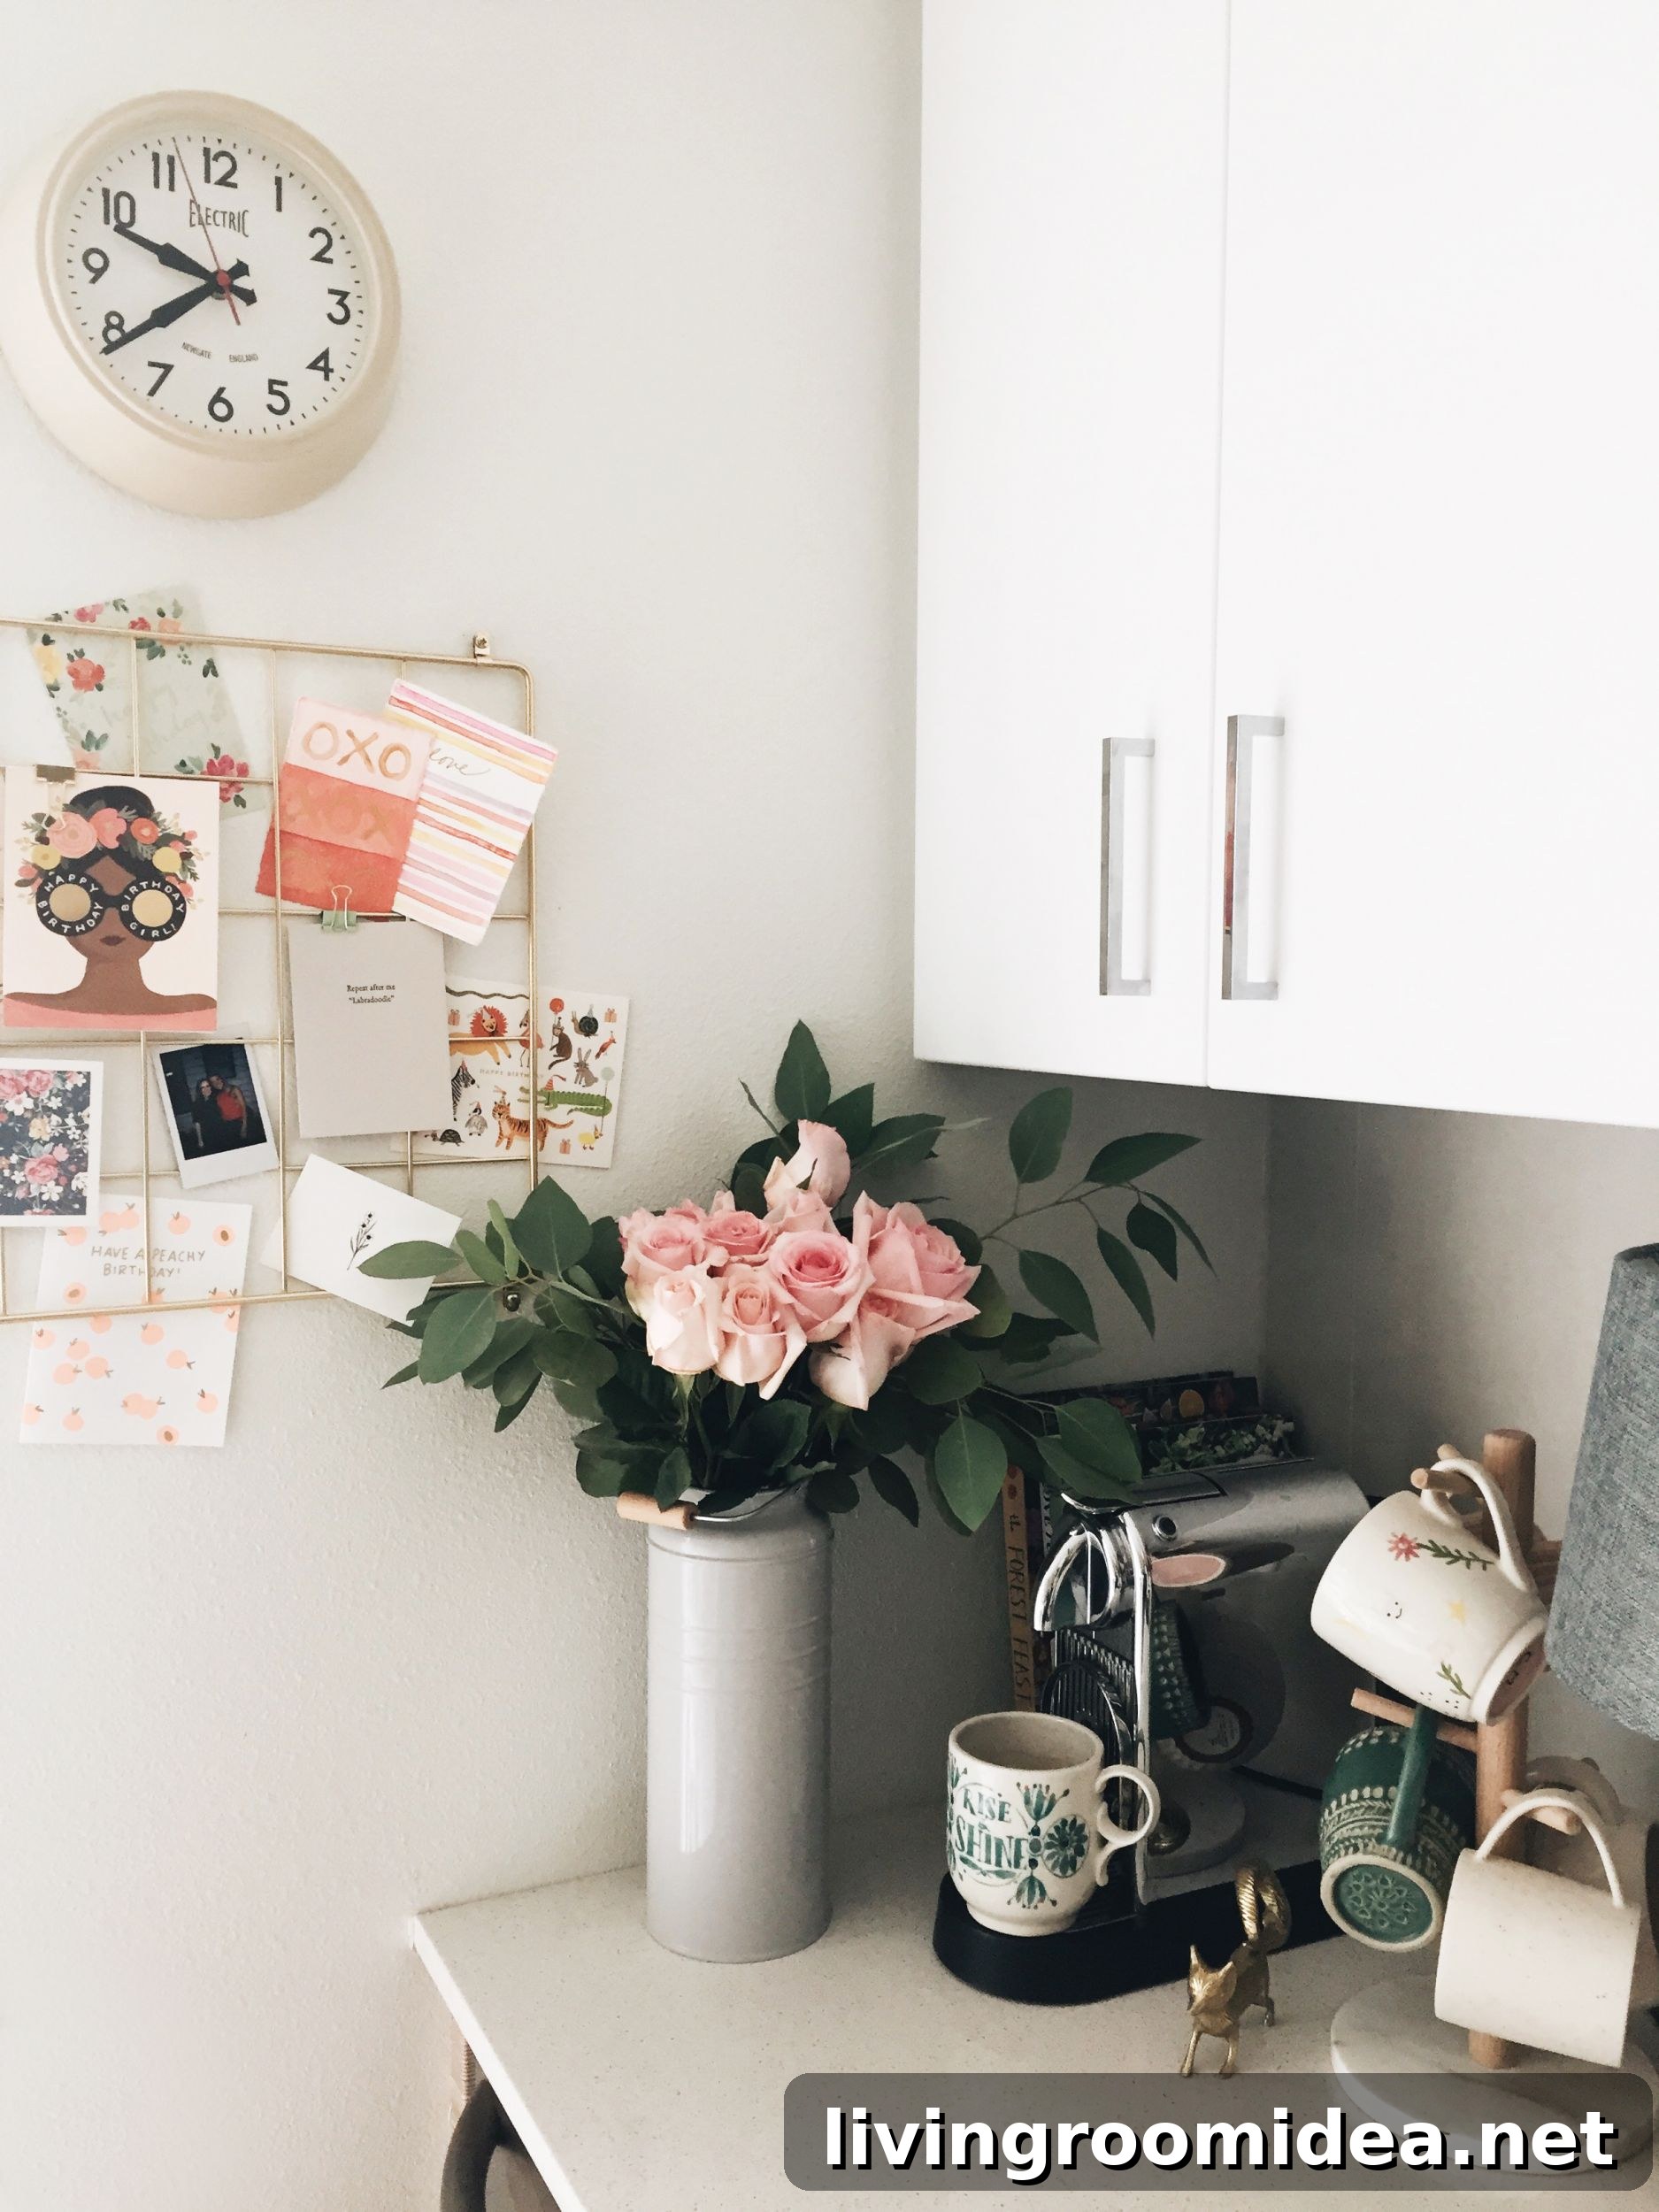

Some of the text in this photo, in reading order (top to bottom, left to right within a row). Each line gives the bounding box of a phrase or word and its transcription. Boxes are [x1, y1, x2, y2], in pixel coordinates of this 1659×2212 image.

[151, 152, 175, 192] 11
[203, 147, 238, 188] 12
[102, 187, 136, 230] 10
[274, 176, 283, 212] 1
[188, 198, 250, 238] ELECTRIC
[309, 227, 334, 264] 2
[82, 247, 110, 284] 9
[326, 288, 351, 326] 3
[102, 311, 127, 349] 8
[228, 352, 259, 363] ENGLAND
[305, 347, 334, 381] 4
[147, 360, 174, 397] 7
[207, 387, 234, 423] 6
[266, 379, 290, 416] 5
[303, 721, 412, 781] OXO
[45, 873, 99, 893] HAPPY
[121, 880, 185, 913] BIRTHDAY
[38, 901, 104, 933] BIRTHDAY
[130, 922, 177, 938] GIRL!
[346, 985, 368, 994] Repeat
[90, 1246, 206, 1263] HAVE A PEACHY
[1007, 1545, 1027, 1624] FOREST
[1012, 1637, 1032, 1701] FEAST
[956, 1815, 1028, 1870] SHINE
